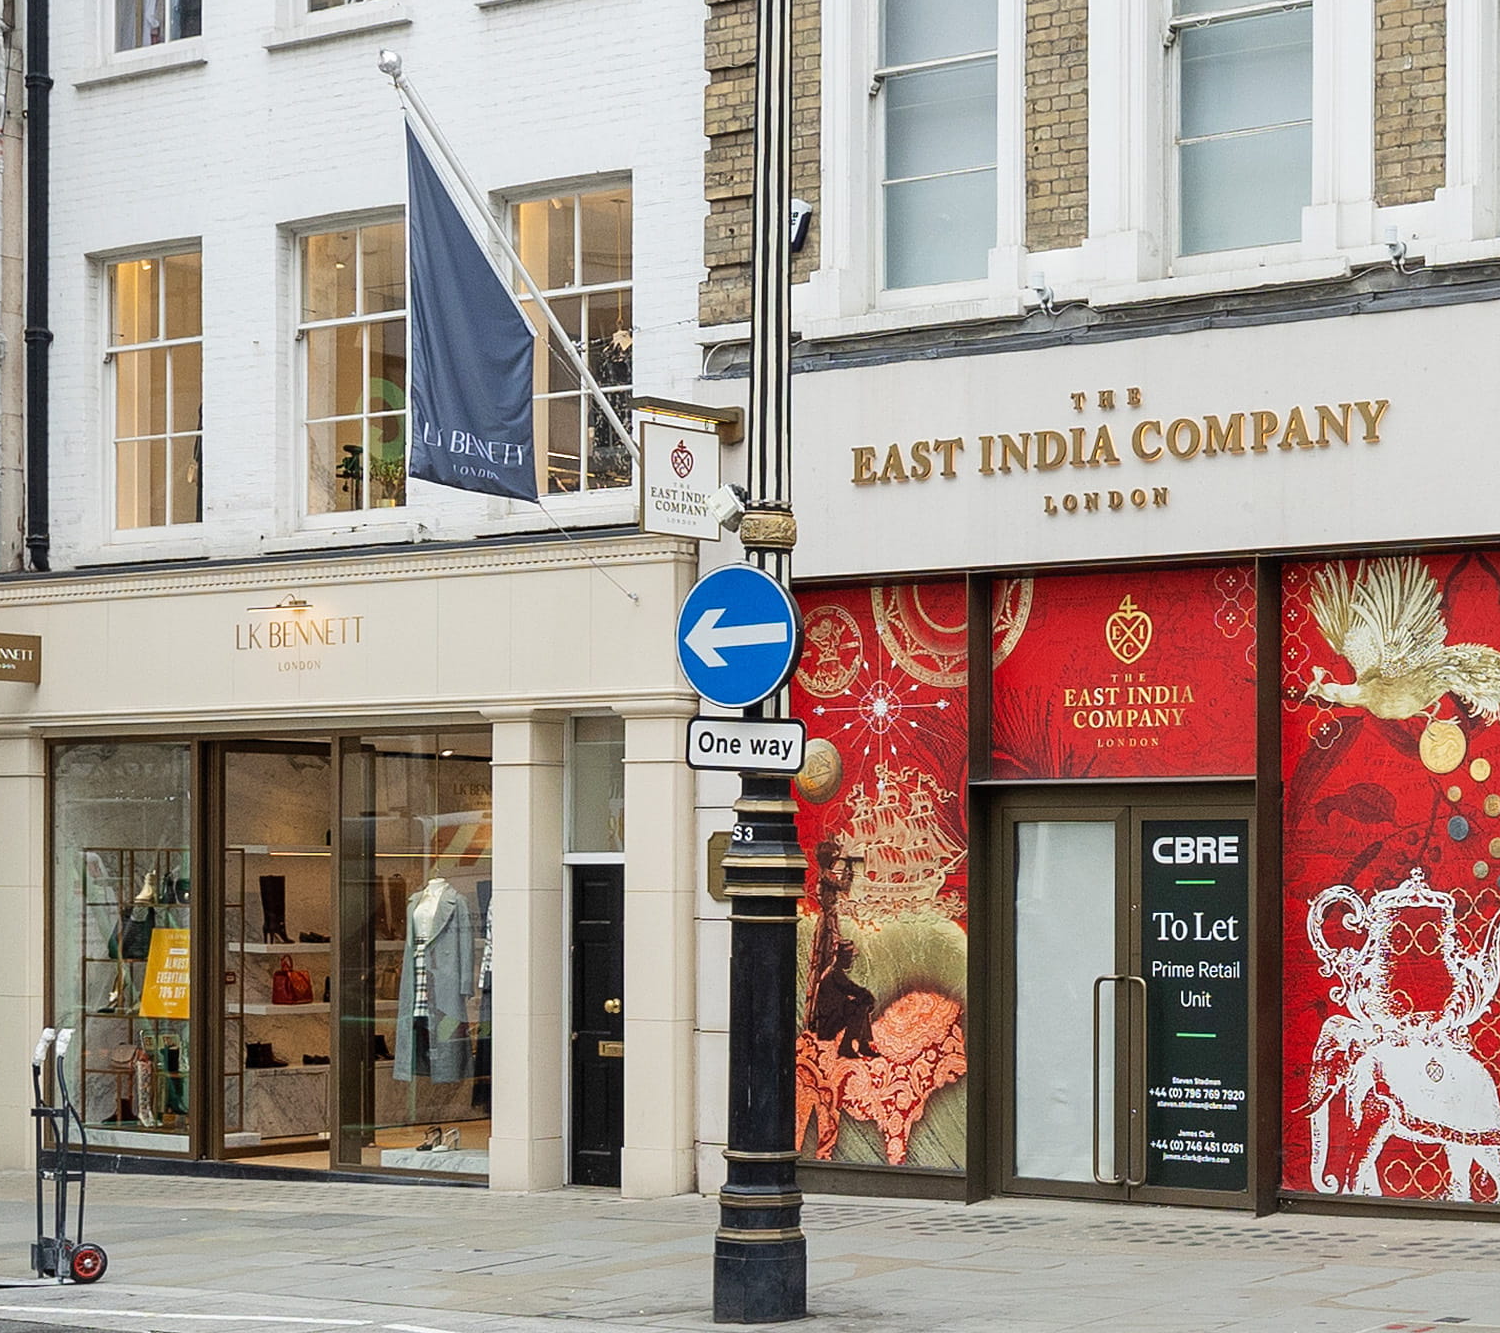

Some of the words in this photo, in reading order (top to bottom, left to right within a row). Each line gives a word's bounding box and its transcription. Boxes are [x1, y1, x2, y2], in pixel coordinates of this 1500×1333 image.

[1070, 386, 1144, 412] THE
[849, 436, 966, 486] EAST
[977, 423, 1122, 476] INDIA
[1130, 398, 1392, 462] COMPANY
[650, 486, 678, 501] EAST
[681, 490, 711, 505] INDI
[1043, 485, 1171, 516] LONDON
[654, 500, 710, 518] COMPANY
[235, 622, 263, 651] LK
[269, 615, 365, 649] BENNETT
[277, 659, 323, 673] LONDON
[1110, 672, 1147, 683] THE
[1063, 686, 1121, 708] EAST
[1126, 684, 1196, 706] INDIA
[1072, 707, 1186, 730] COMPANY
[698, 730, 742, 755] One
[750, 737, 794, 761] way
[1096, 736, 1160, 748] LONDON
[1151, 835, 1240, 865] CBRE
[1151, 912, 1189, 942] To
[1193, 911, 1240, 942] Let
[1151, 960, 1195, 979] Prime
[1198, 960, 1241, 980] Retail
[1180, 990, 1213, 1009] Unit
[1149, 1087, 1167, 1098] +44
[1168, 1087, 1183, 1100] (0)
[1222, 1089, 1246, 1101] 7920
[1150, 1139, 1168, 1150] +44
[1169, 1139, 1184, 1152] (0)
[1185, 1140, 1203, 1152] 746
[1204, 1141, 1221, 1153] 451
[1221, 1142, 1245, 1154] 0261
